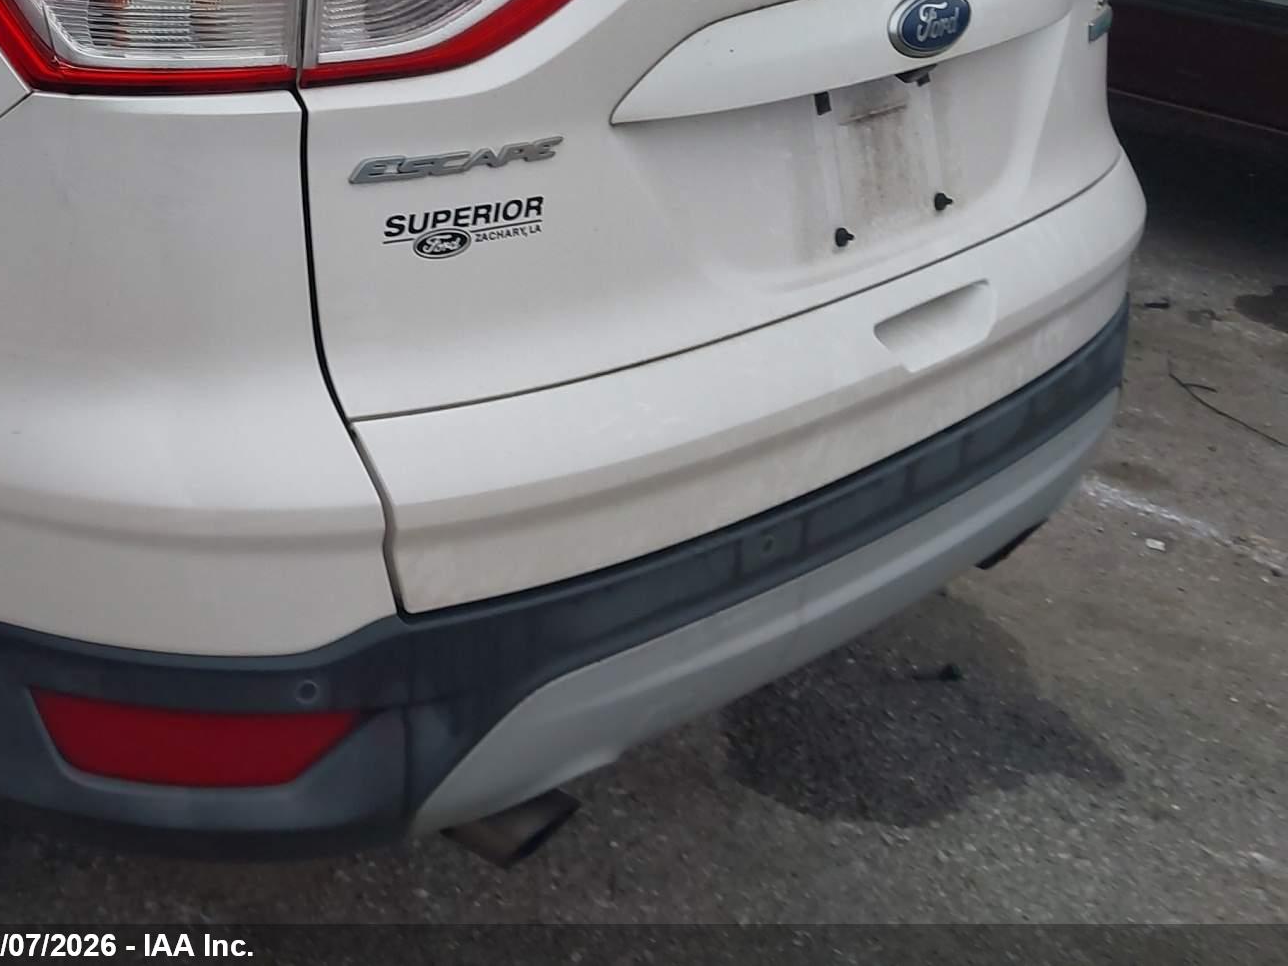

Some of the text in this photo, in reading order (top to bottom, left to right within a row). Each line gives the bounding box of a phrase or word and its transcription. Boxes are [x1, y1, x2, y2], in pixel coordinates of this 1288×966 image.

[916, 1, 961, 42] Ford
[348, 136, 564, 184] ESCAPE
[383, 196, 544, 238] SUPERIOR
[528, 224, 542, 235] LA
[422, 233, 462, 254] Ford
